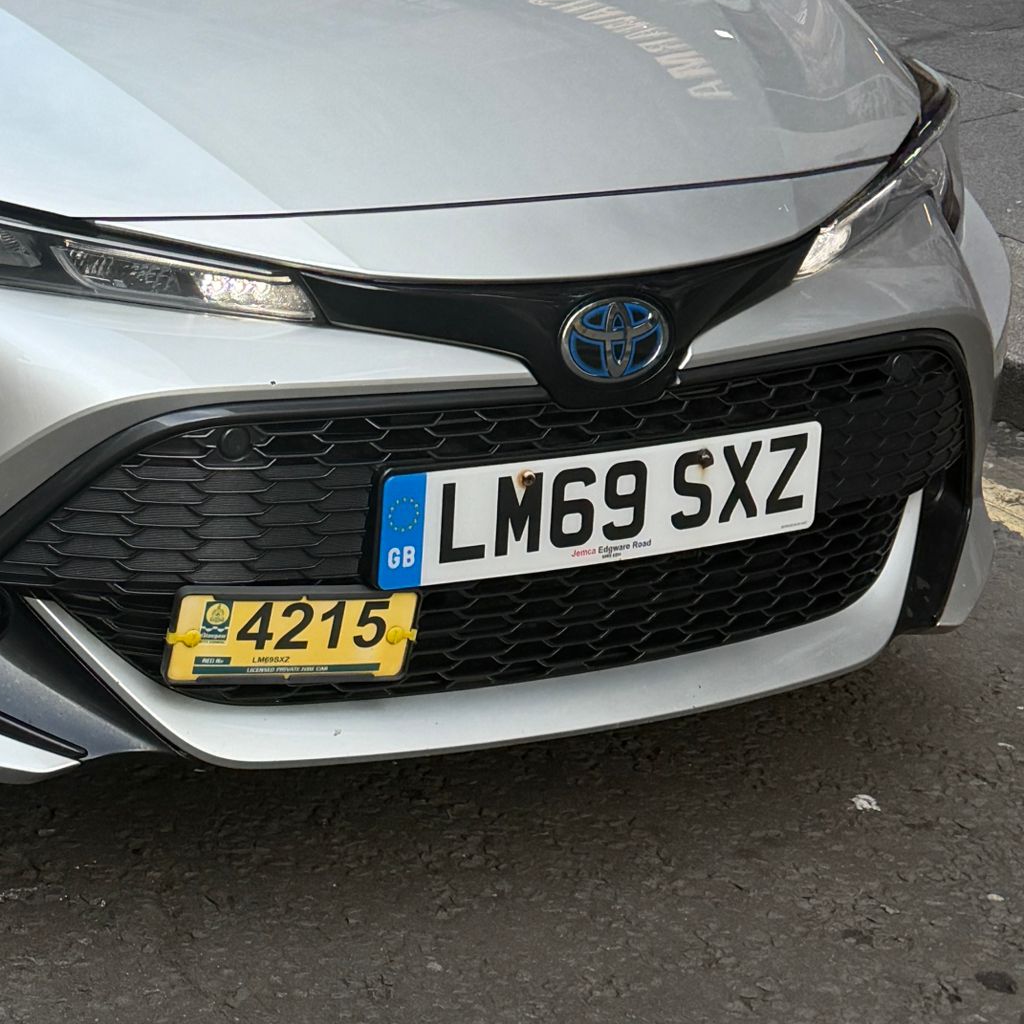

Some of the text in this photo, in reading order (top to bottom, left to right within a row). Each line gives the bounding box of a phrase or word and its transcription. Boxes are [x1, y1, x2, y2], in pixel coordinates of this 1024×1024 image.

[439, 433, 809, 564] LM69 SXZ
[388, 545, 416, 569] GB
[571, 548, 596, 558] Jemca
[598, 544, 631, 555] Edgware
[633, 539, 652, 549] Road
[236, 601, 390, 651] 4215
[252, 656, 290, 664] LM69SXZ
